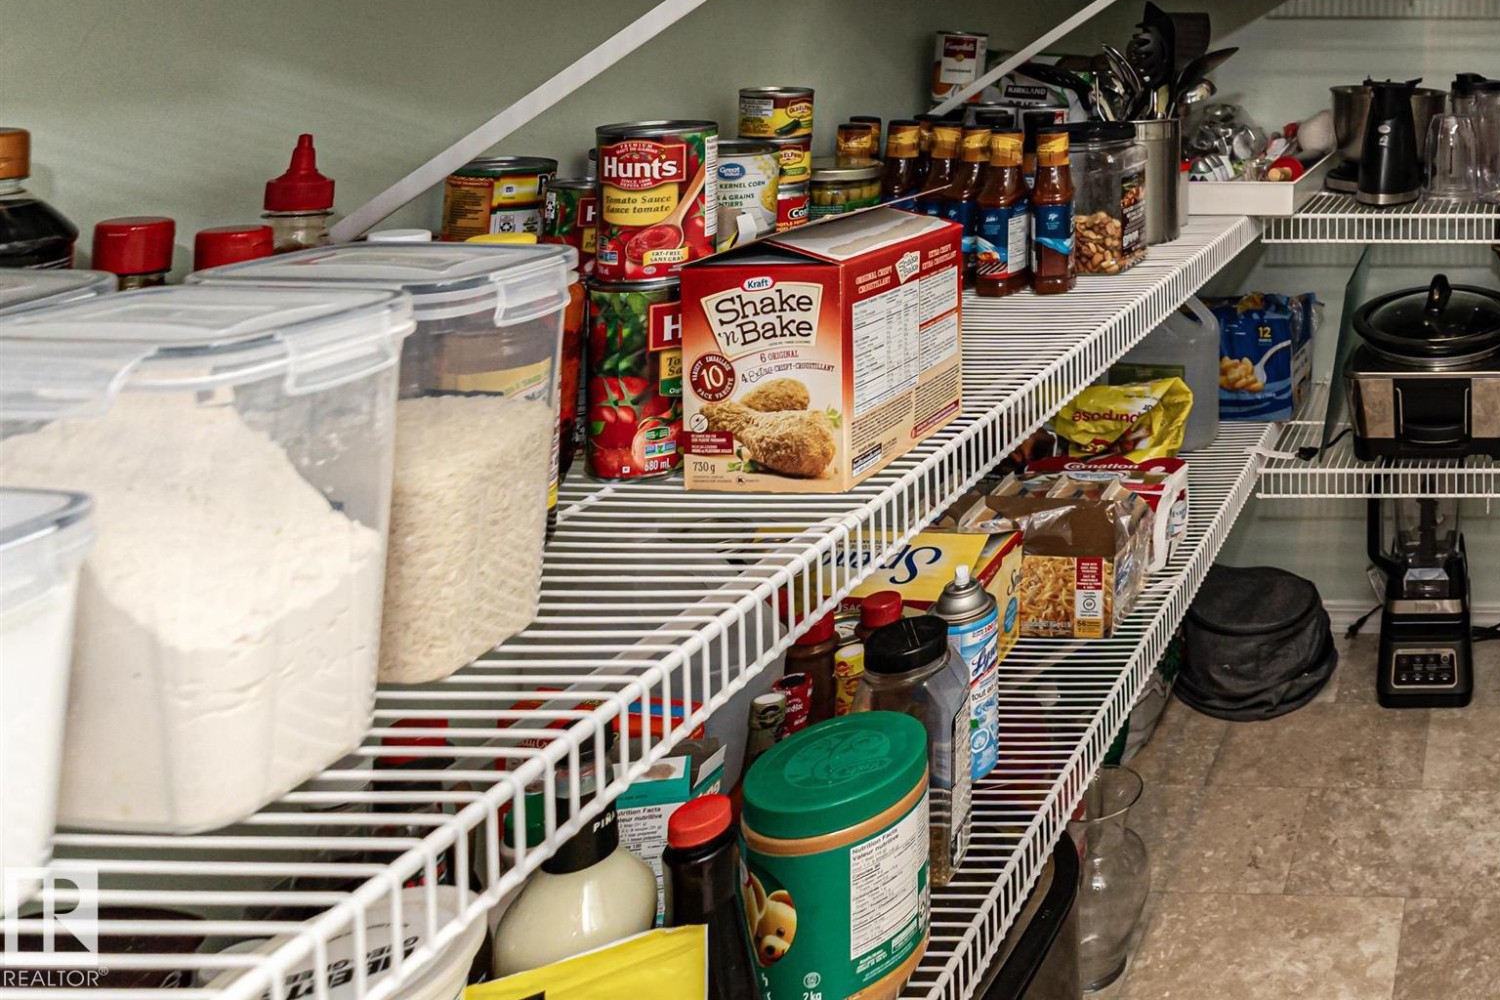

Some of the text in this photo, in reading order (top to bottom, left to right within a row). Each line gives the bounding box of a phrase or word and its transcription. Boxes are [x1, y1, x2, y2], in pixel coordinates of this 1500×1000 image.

[720, 166, 740, 174] Great
[605, 195, 671, 204] Tomato Sauce
[605, 204, 671, 214] Sauce tomate
[747, 278, 769, 289] Kraft
[714, 289, 813, 327] Shake
[718, 314, 813, 346] 'n Bake
[1258, 326, 1271, 338] 12
[760, 350, 799, 363] 6 ORIGINAL
[692, 356, 731, 382] VARIETY EMBALLAGE
[701, 365, 724, 389] 10
[741, 374, 748, 384] 4
[697, 388, 713, 400] PACK
[644, 458, 670, 471] 680 mL
[693, 462, 709, 471] 730
[1064, 462, 1140, 470] Carnation
[972, 646, 998, 677] Lys
[972, 690, 984, 701] tout
[617, 806, 661, 816] utrition Facts
[634, 813, 662, 822] nutritive
[852, 828, 898, 855] Nutrition Facts
[852, 834, 899, 861] Valeur nutritive
